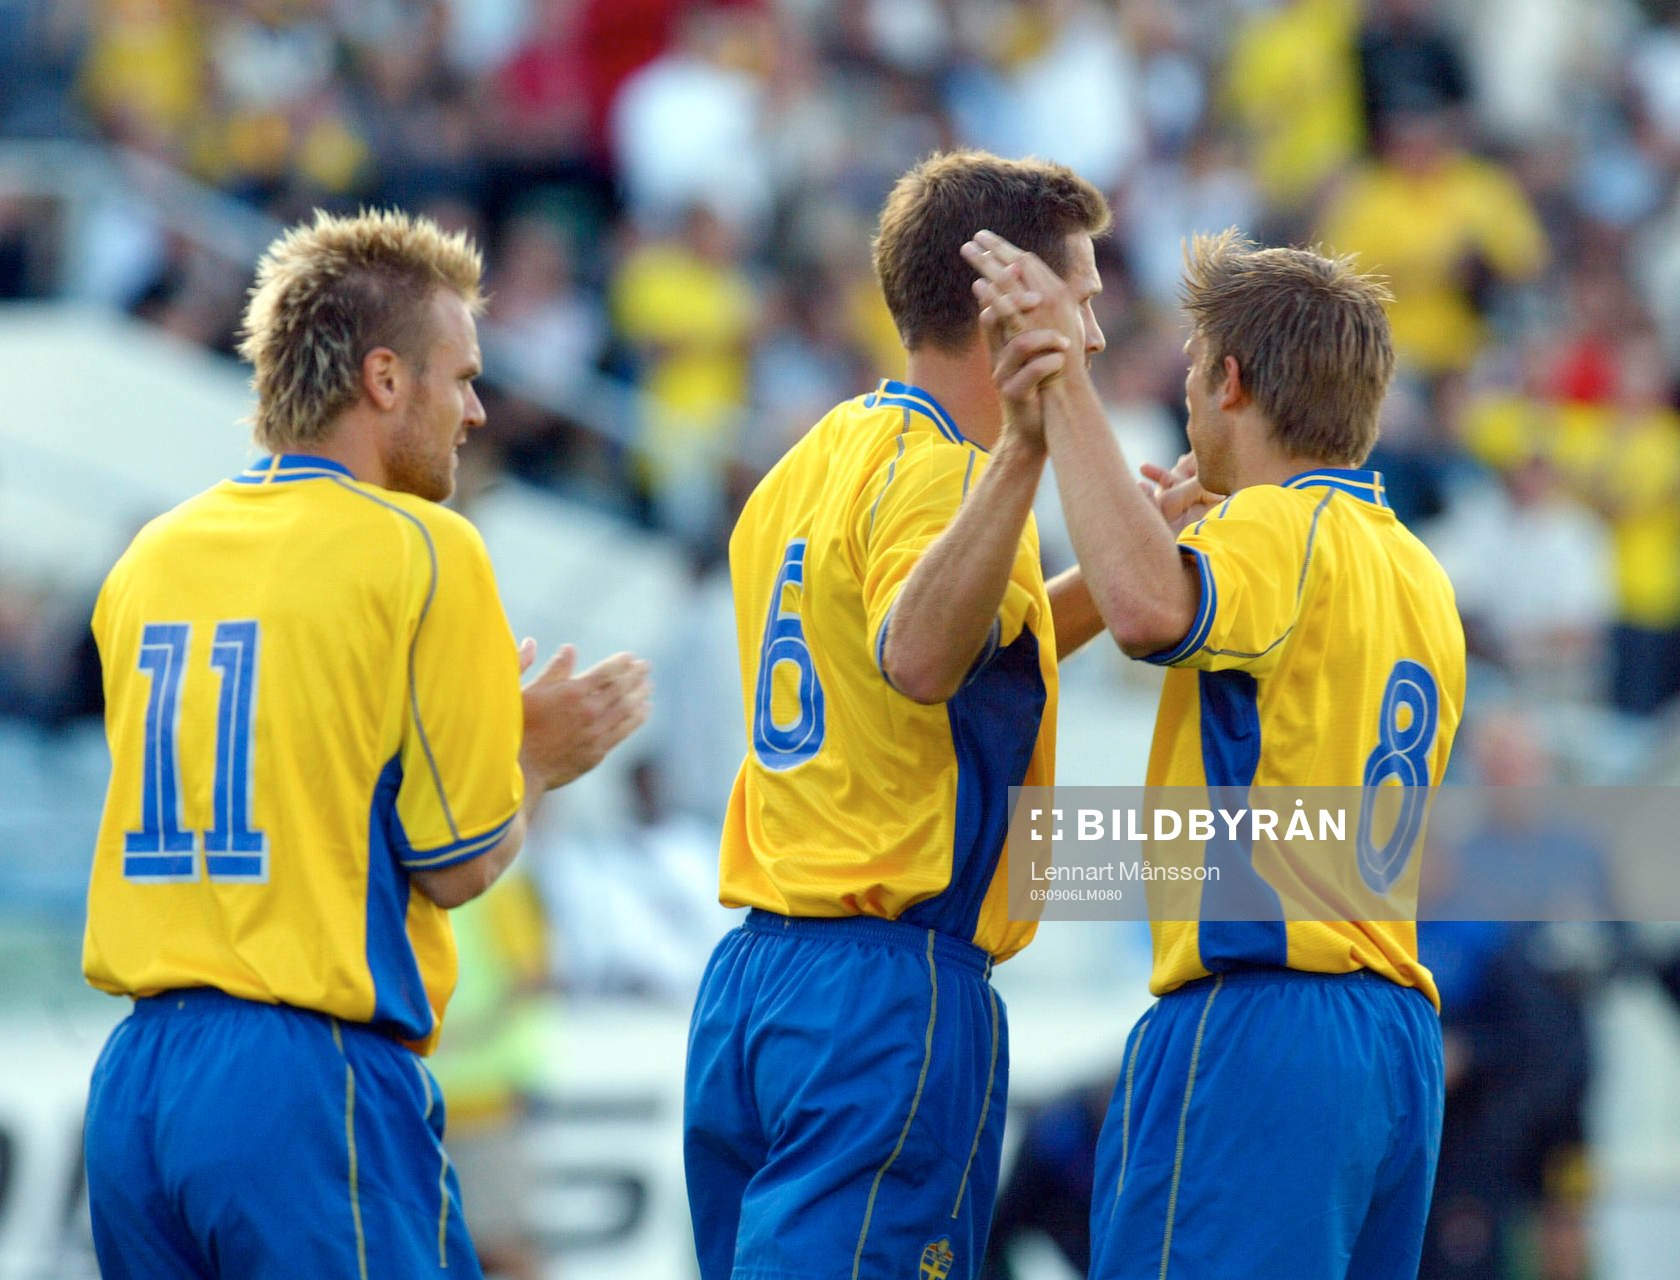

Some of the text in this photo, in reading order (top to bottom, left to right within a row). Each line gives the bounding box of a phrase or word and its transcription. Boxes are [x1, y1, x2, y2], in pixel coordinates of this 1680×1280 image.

[123, 619, 271, 884] 11
[752, 537, 827, 773] 6
[1355, 657, 1440, 896] 8
